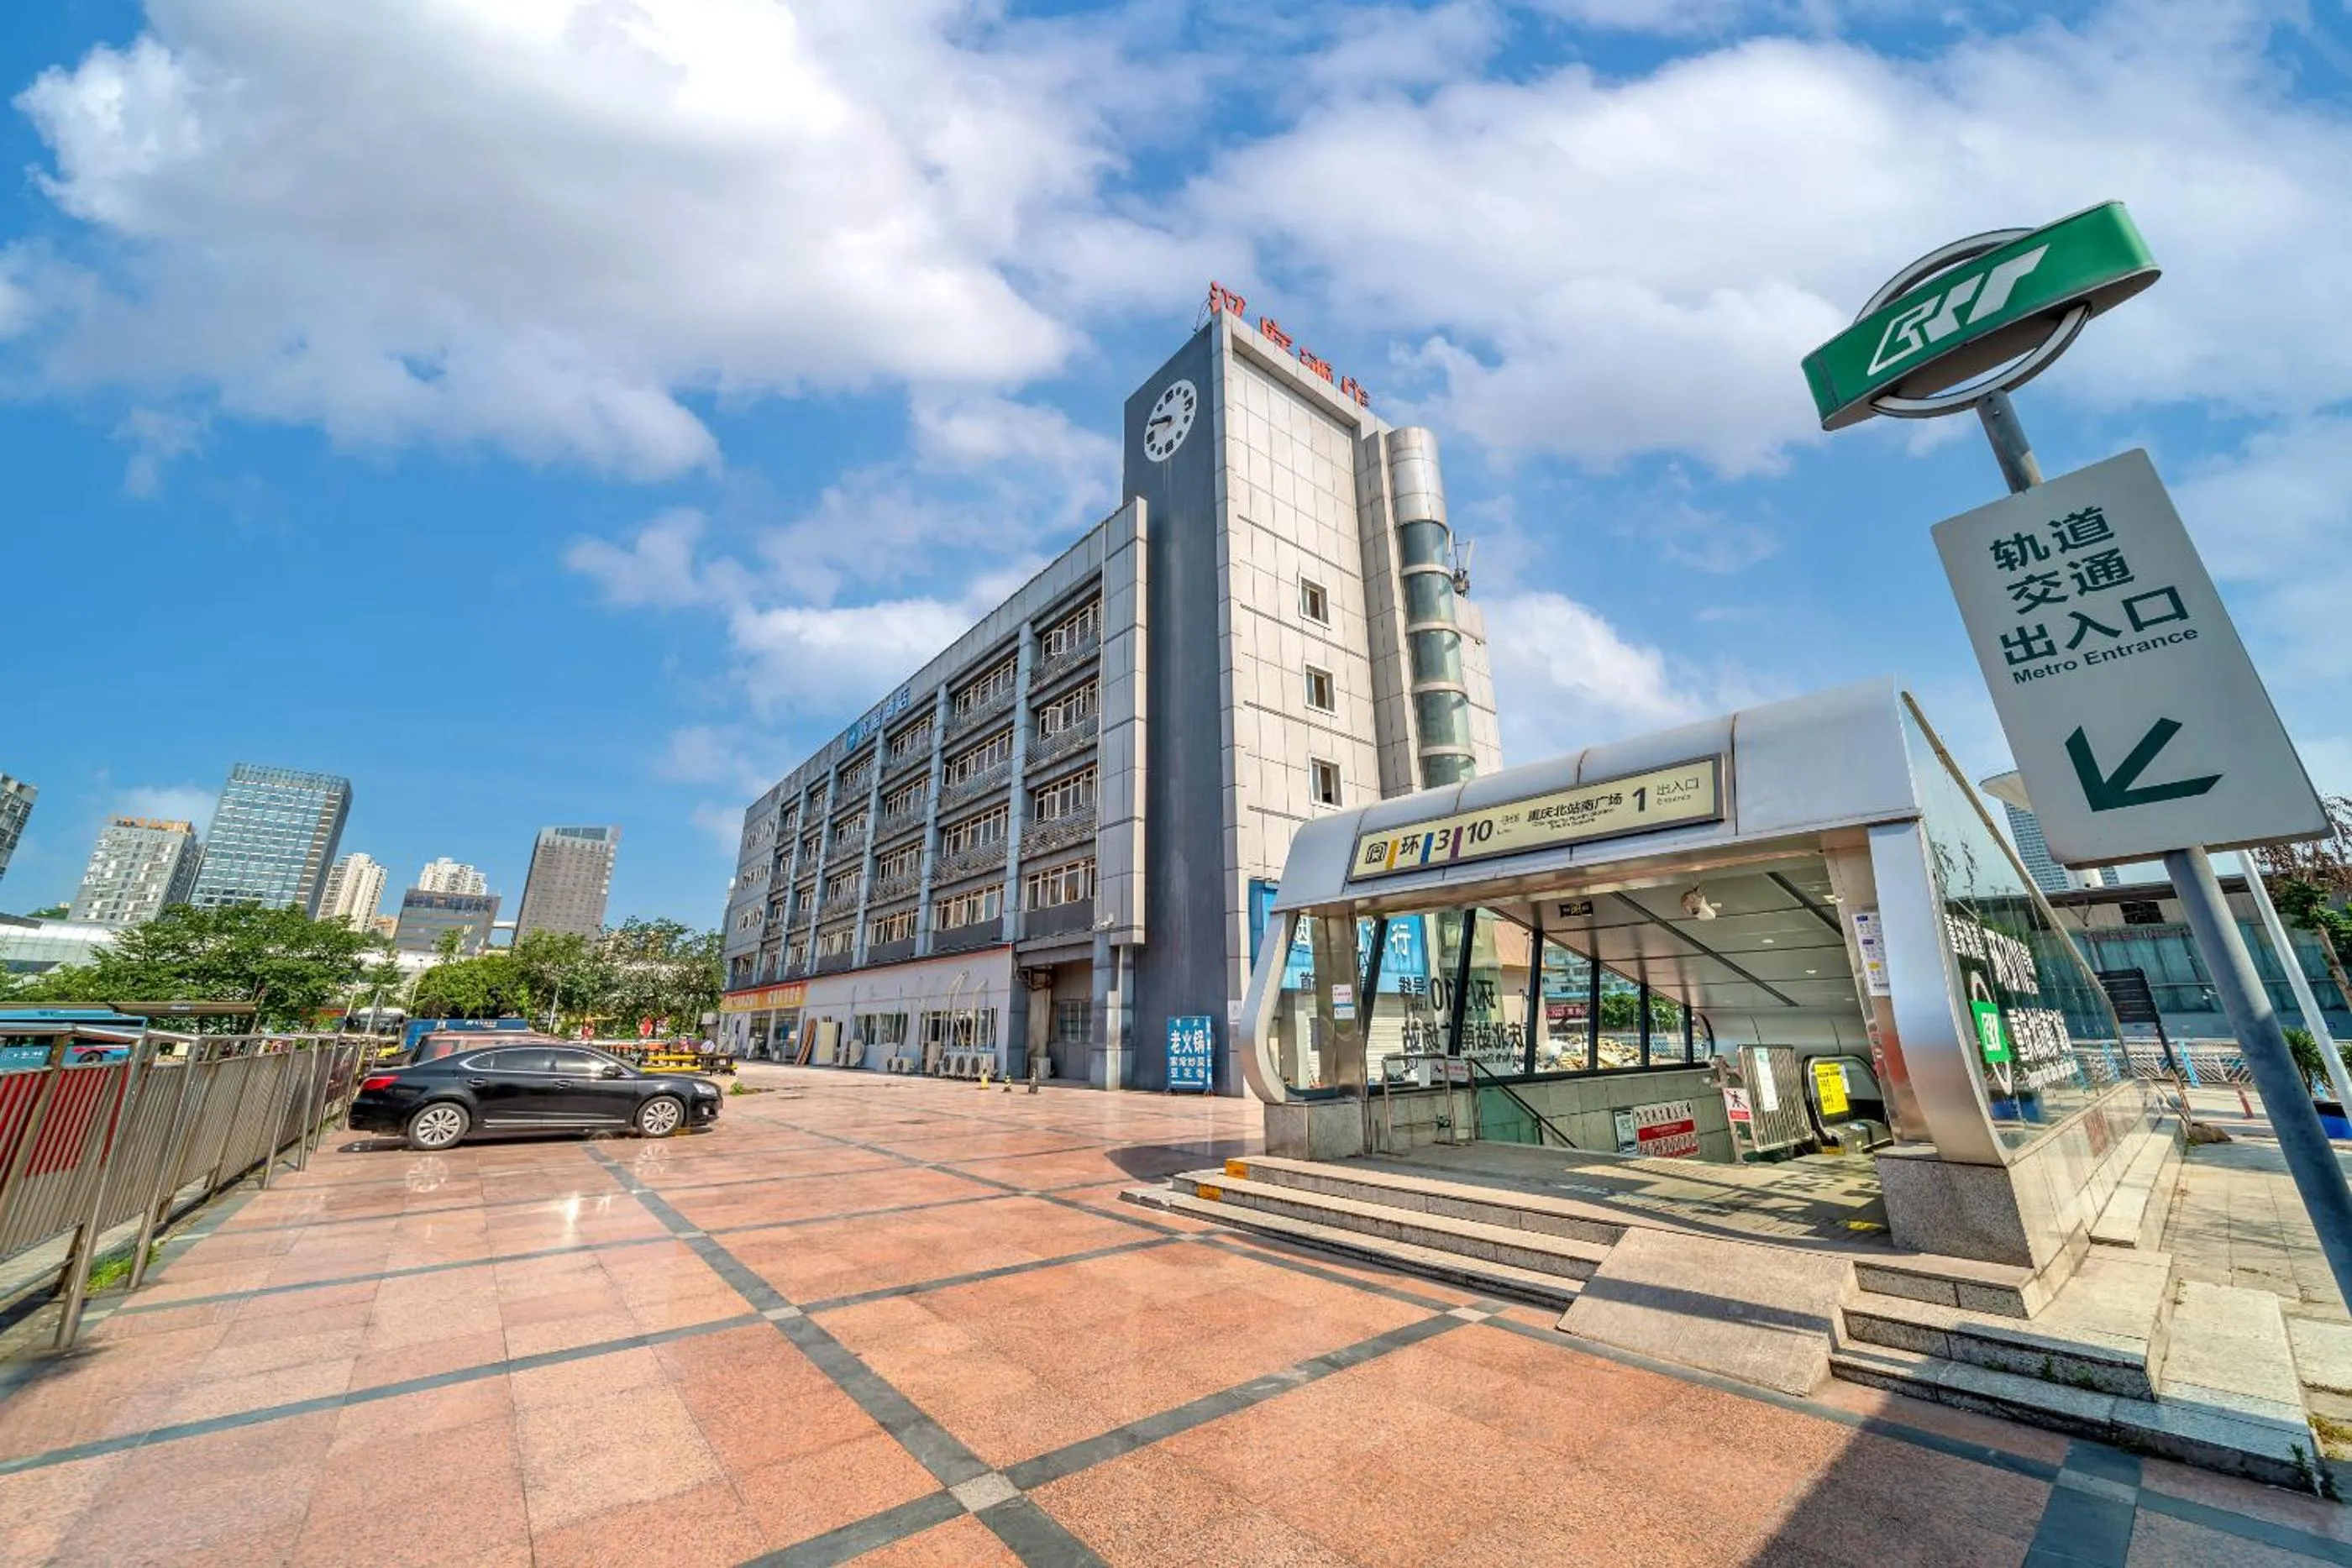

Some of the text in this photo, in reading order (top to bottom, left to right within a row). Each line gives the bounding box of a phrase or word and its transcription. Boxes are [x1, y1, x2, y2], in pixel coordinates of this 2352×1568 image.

[1989, 506, 2115, 572] 轨道
[2007, 547, 2135, 607] 交通
[1999, 585, 2189, 666] 出入口
[2013, 627, 2198, 684] Metro Entrance
[1399, 834, 1421, 856] 环
[1435, 829, 1451, 851] 3
[1467, 820, 1494, 844] 10
[1527, 793, 1623, 822] 重庆北站南广场
[1632, 787, 1646, 812] 1
[1656, 778, 1698, 796] 出入口
